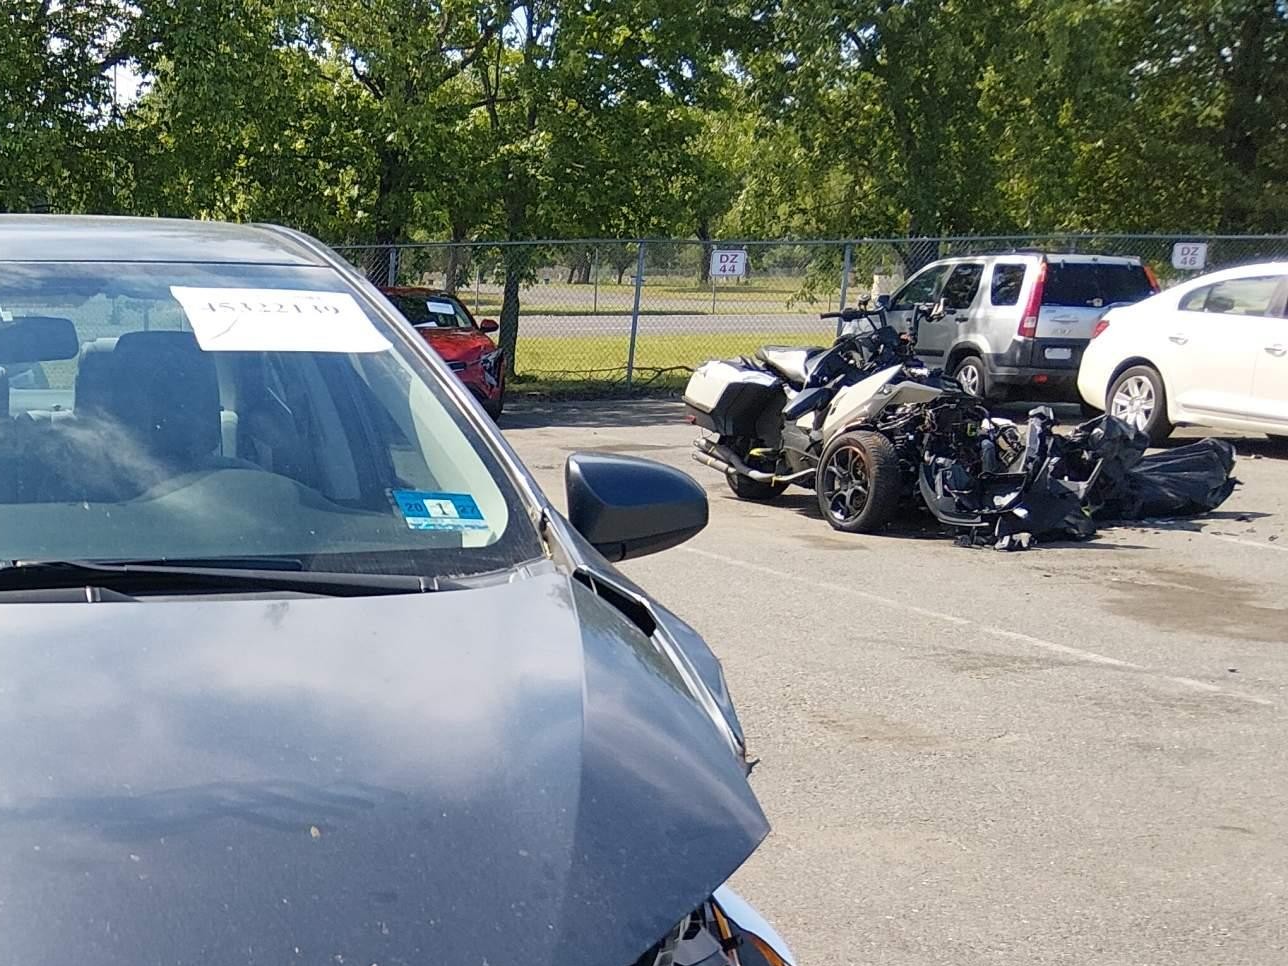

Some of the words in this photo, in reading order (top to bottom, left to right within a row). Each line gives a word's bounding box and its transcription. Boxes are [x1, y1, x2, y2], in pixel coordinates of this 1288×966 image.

[1182, 247, 1200, 256] DZ
[719, 254, 739, 264] DZ
[1180, 257, 1197, 265] 46
[719, 264, 736, 273] 44
[436, 502, 449, 516] 1
